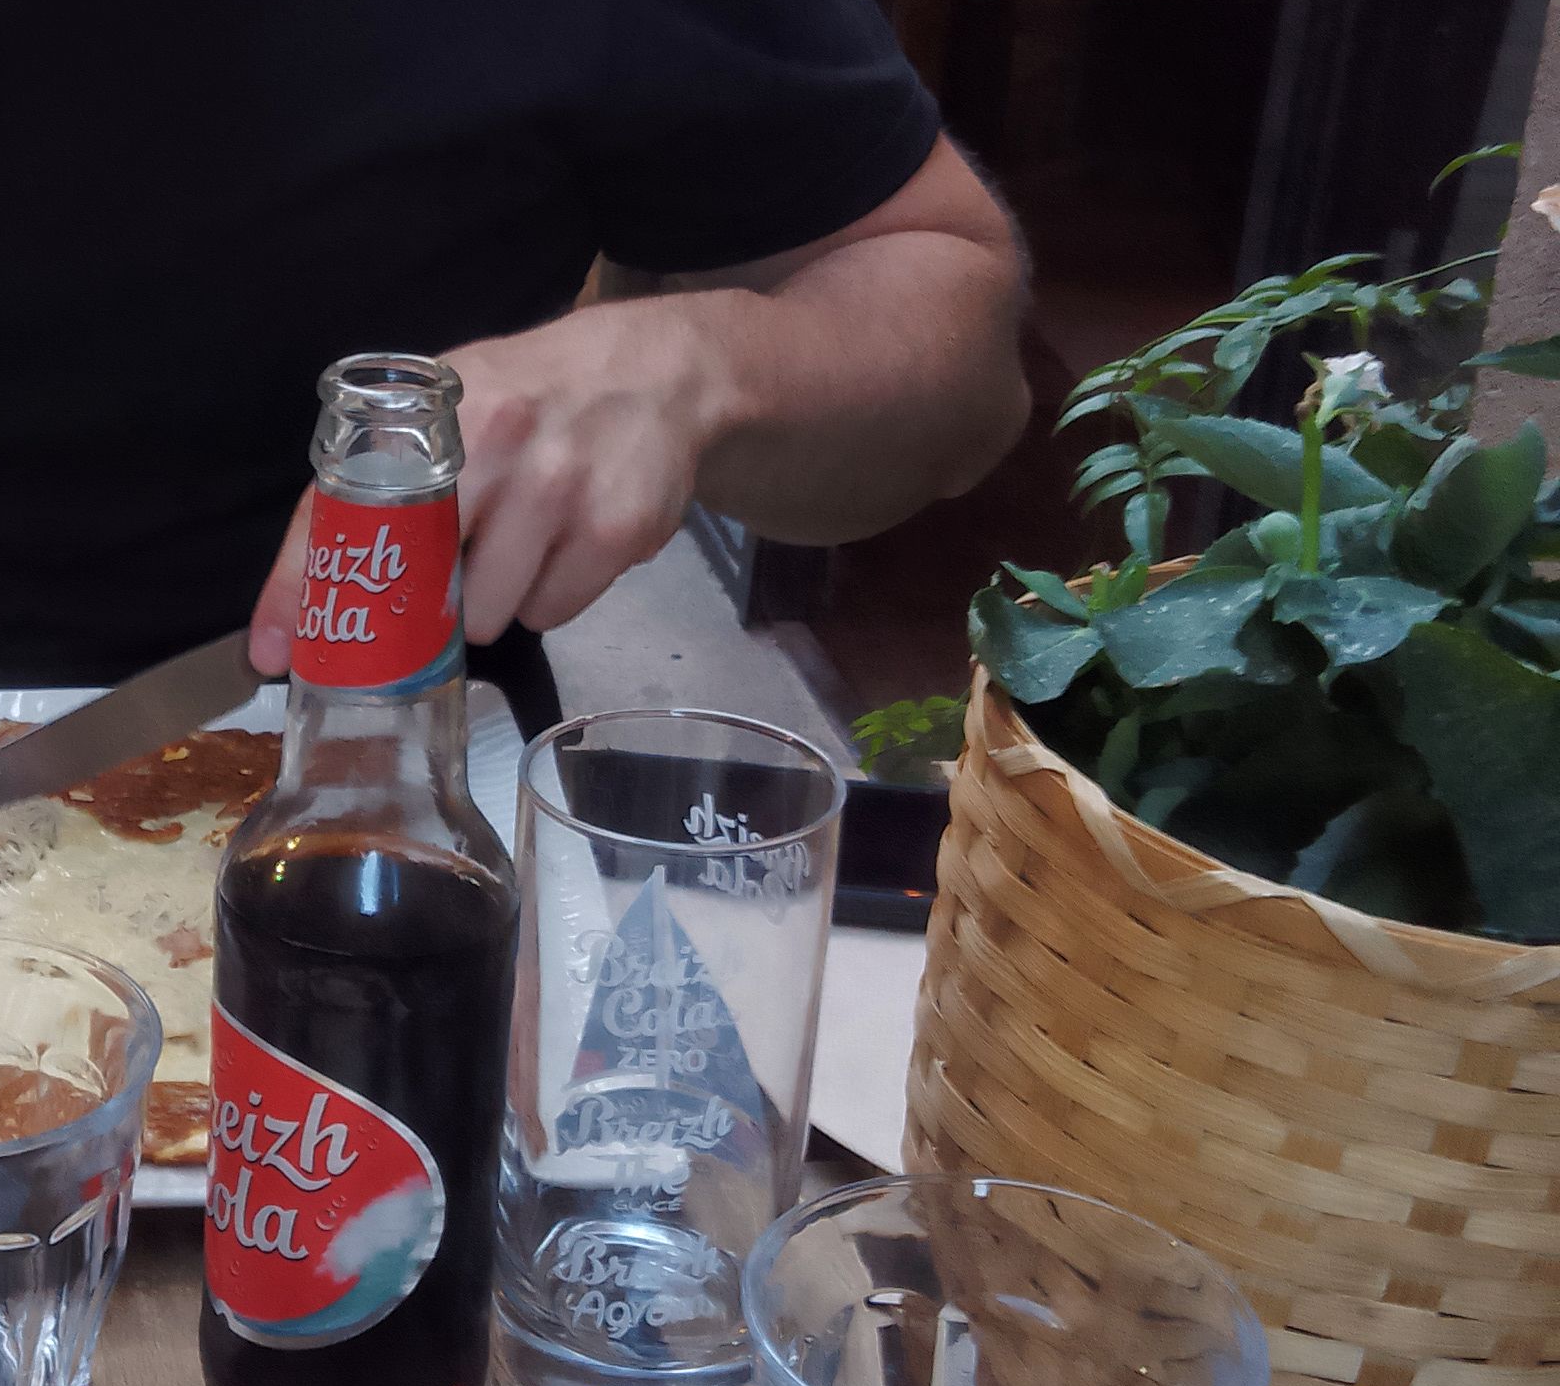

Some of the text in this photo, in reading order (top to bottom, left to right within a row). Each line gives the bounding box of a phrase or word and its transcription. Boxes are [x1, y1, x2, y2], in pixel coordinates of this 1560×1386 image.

[307, 524, 407, 593] reizh
[602, 987, 737, 1039] Cola
[616, 1046, 708, 1074] ZERO
[559, 1095, 735, 1150] Breizh
